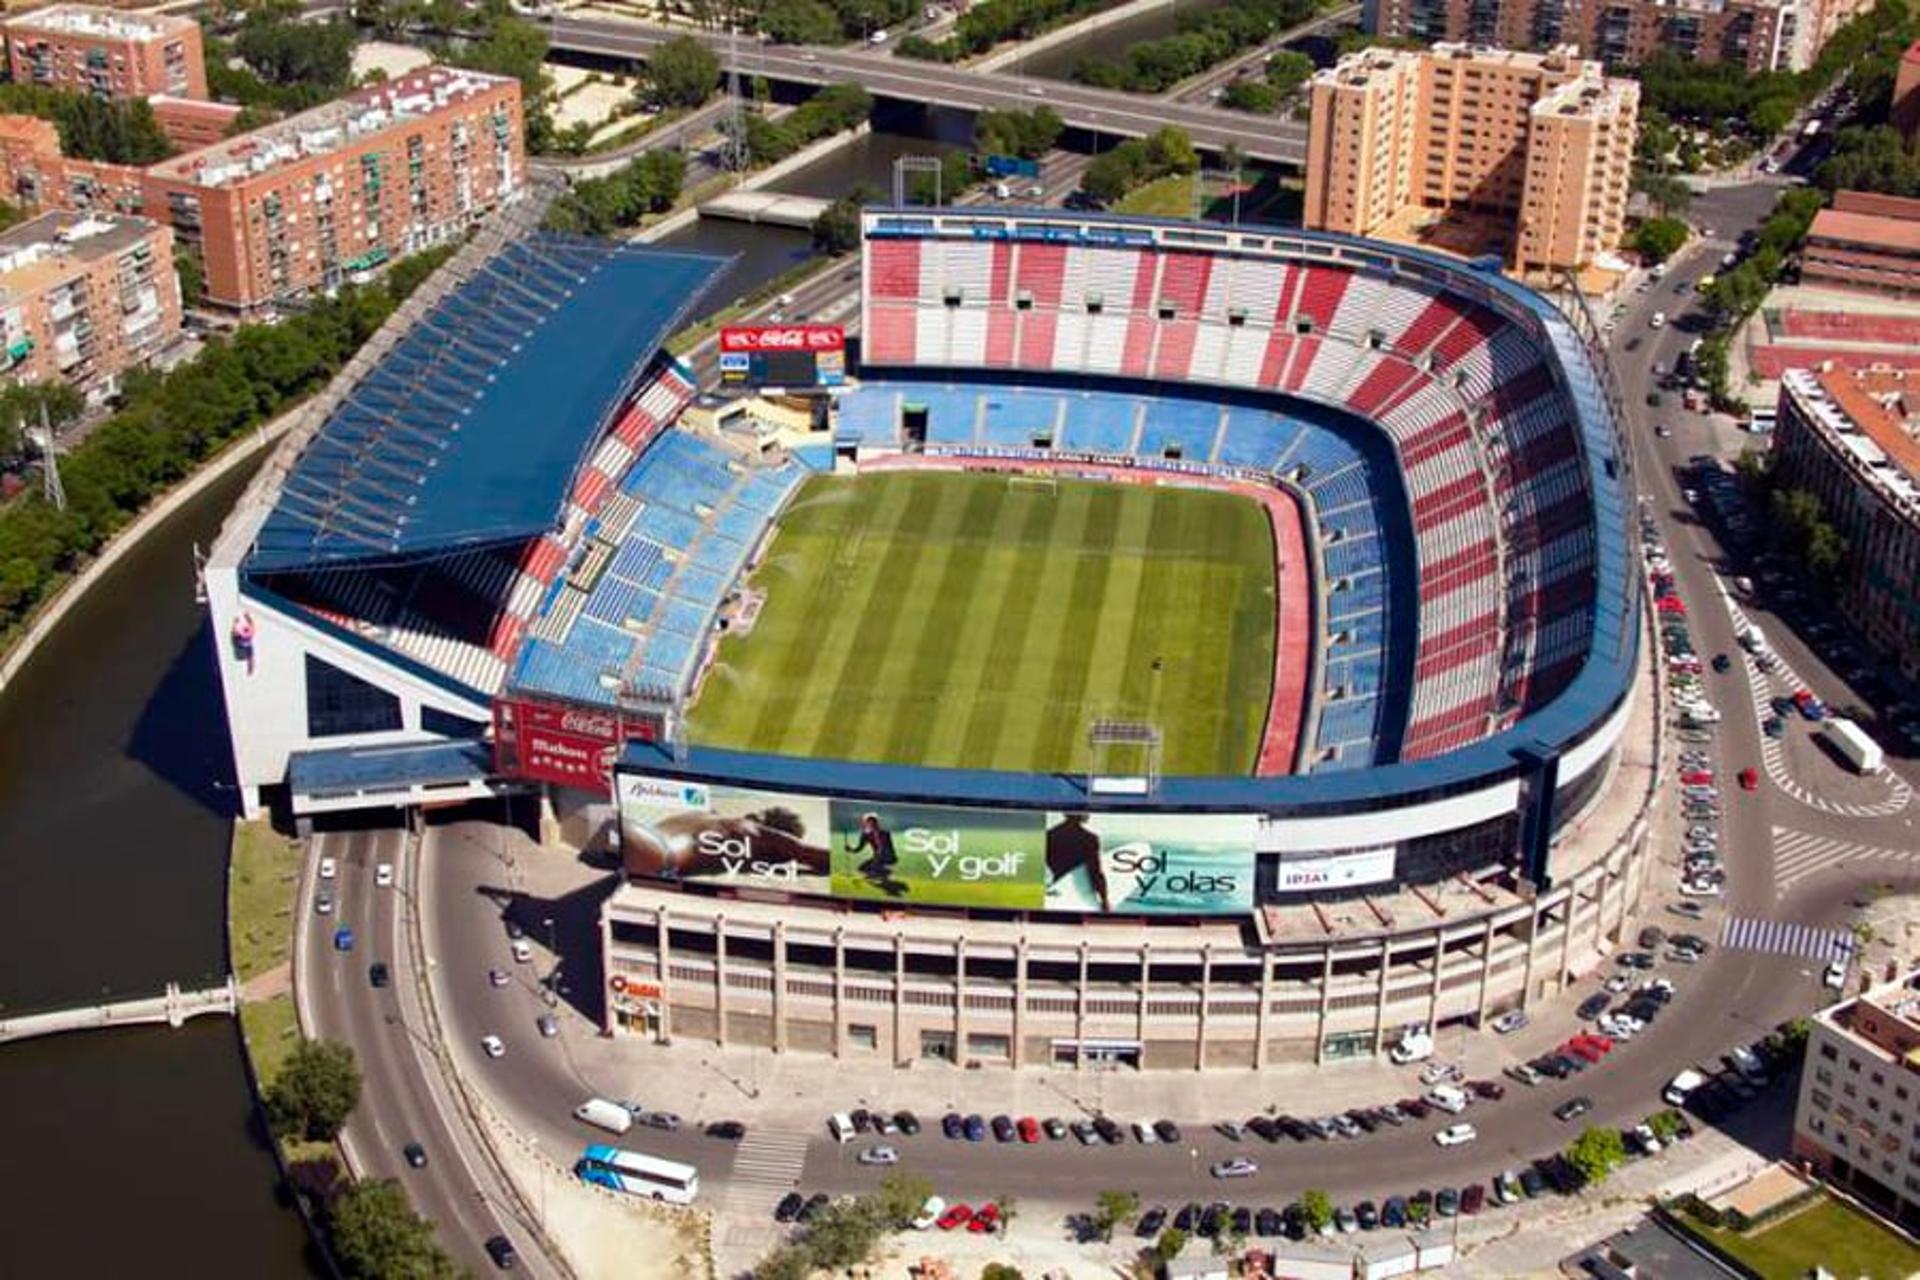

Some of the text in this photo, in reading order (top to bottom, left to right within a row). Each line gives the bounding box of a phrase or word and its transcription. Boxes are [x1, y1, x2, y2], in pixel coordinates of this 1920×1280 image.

[699, 831, 752, 859] Sol
[904, 828, 960, 854] Sol
[721, 857, 745, 879] y
[927, 852, 1026, 880] y golf
[1112, 850, 1167, 875] Sol
[1135, 870, 1235, 896] y olas
